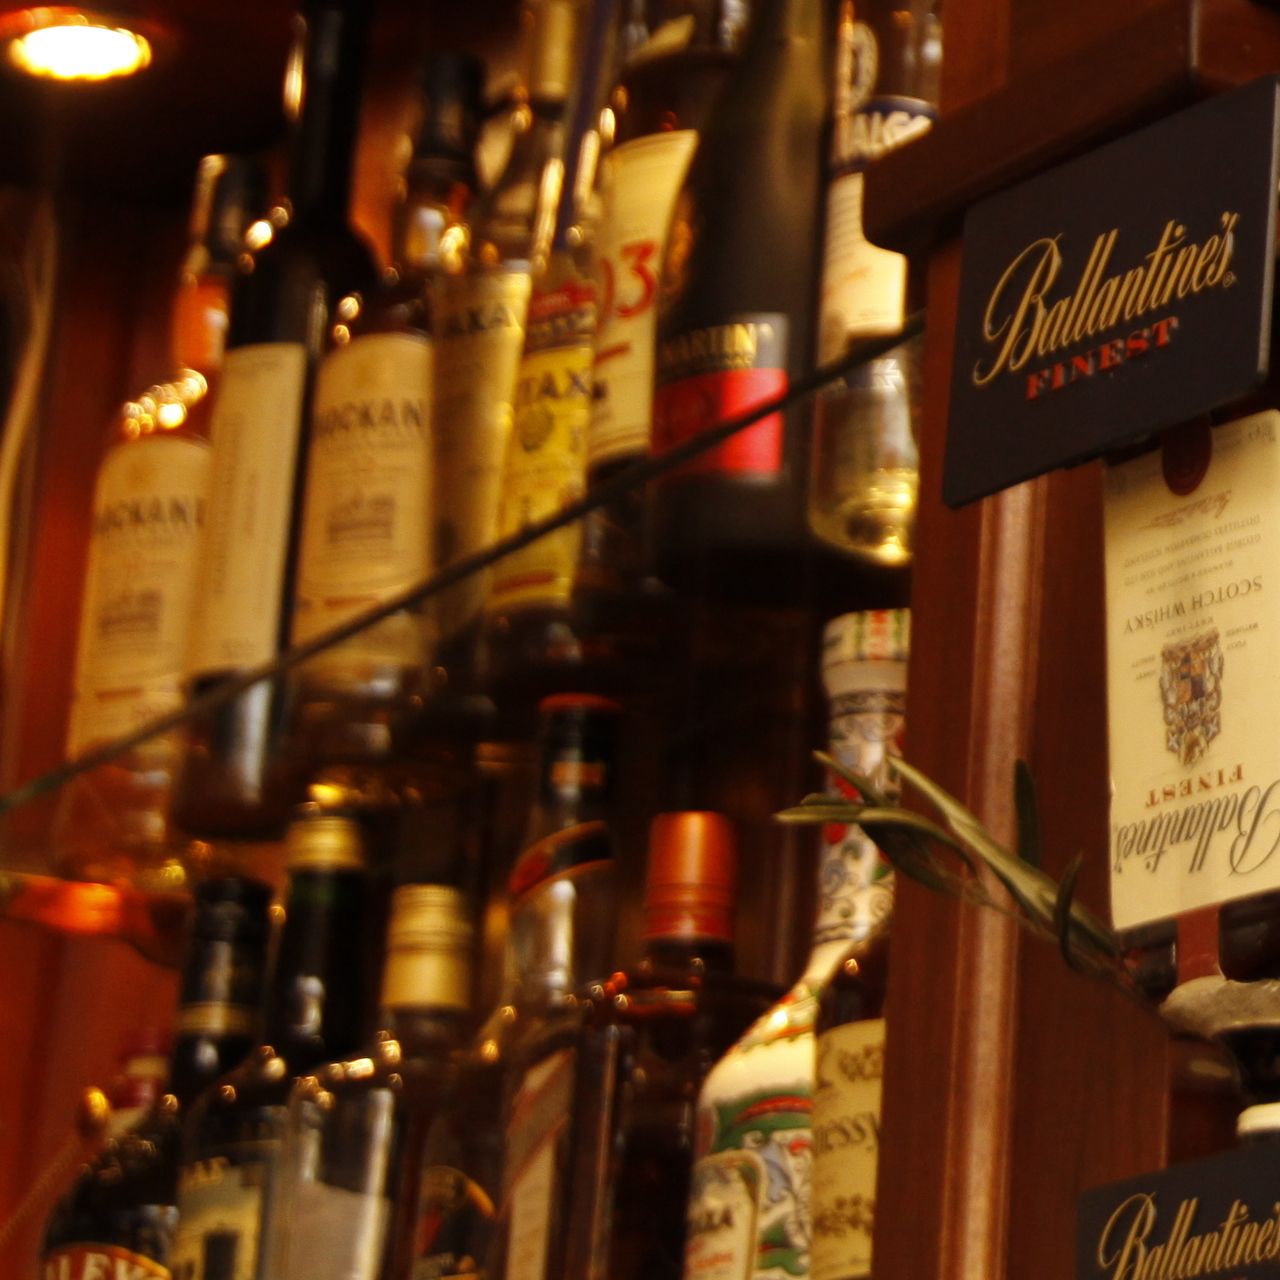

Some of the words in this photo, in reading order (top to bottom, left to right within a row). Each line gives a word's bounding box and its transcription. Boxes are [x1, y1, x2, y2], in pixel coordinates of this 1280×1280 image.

[971, 210, 1240, 387] Ballantine's
[1025, 315, 1180, 401] FINEST
[1122, 595, 1187, 635] WHISKY
[1189, 575, 1264, 610] SCOTCH
[1144, 762, 1245, 809] FINEST
